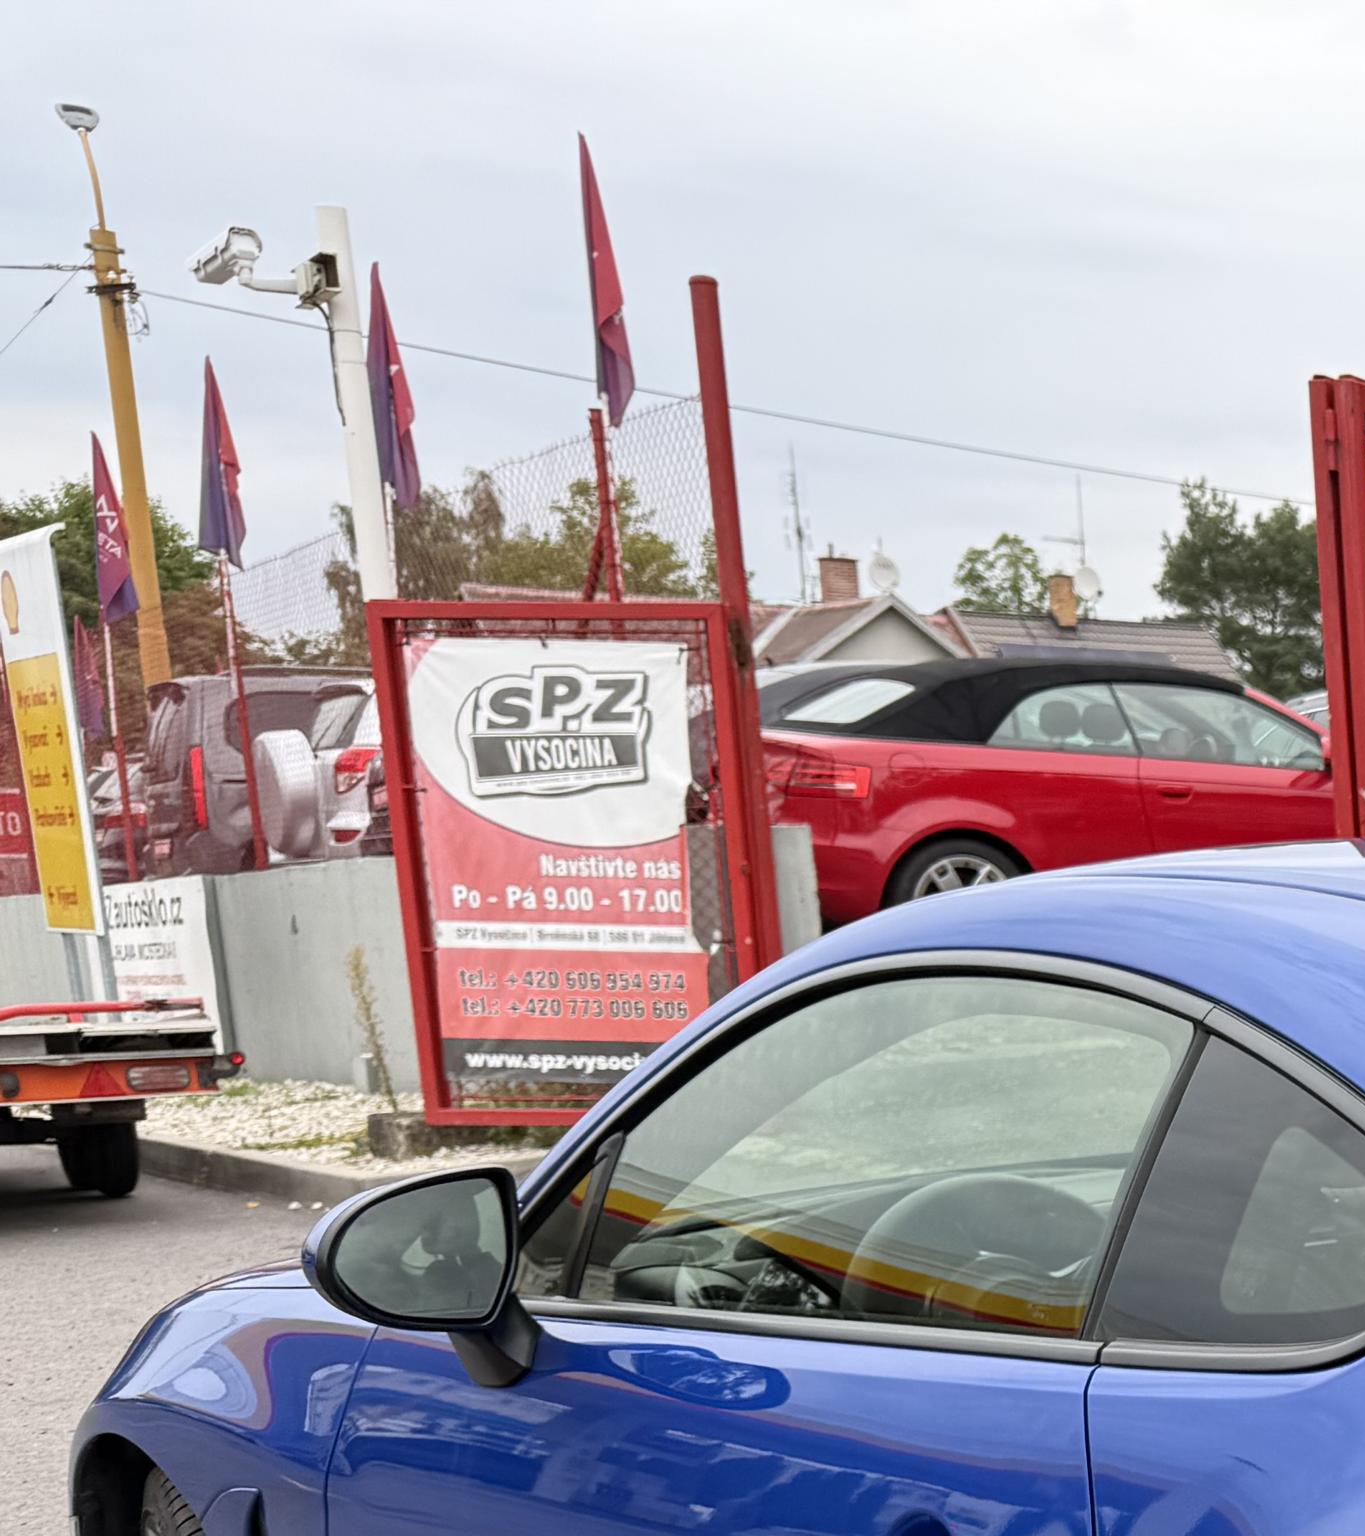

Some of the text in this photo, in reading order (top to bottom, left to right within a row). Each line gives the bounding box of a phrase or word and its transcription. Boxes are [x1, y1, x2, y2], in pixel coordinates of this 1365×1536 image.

[643, 857, 682, 880] nás
[451, 883, 481, 909] Po
[505, 885, 538, 910] Pá
[543, 887, 594, 911] 9.00
[618, 888, 682, 912] 17.00
[504, 969, 560, 990] +420
[506, 997, 562, 1018] +420
[566, 998, 605, 1018] 773
[464, 1051, 646, 1074] www.spz-vysoci
